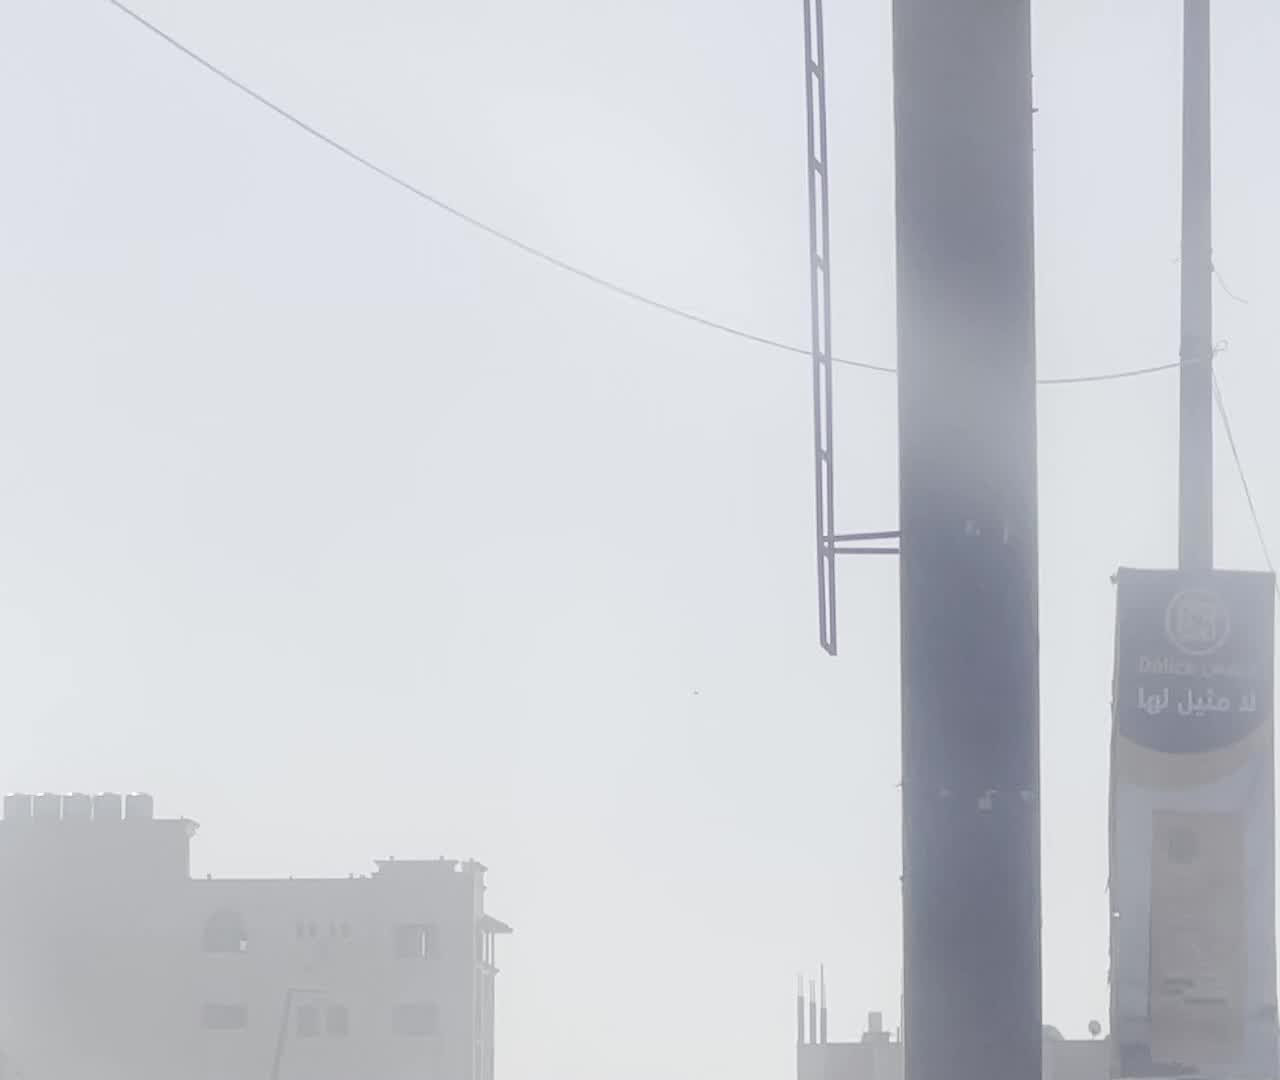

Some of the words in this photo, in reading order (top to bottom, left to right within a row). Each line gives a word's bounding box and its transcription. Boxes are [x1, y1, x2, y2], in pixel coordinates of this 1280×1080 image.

[1137, 687, 1169, 716] لها
[1177, 687, 1232, 717] مثيل
[1239, 687, 1256, 712] لا
